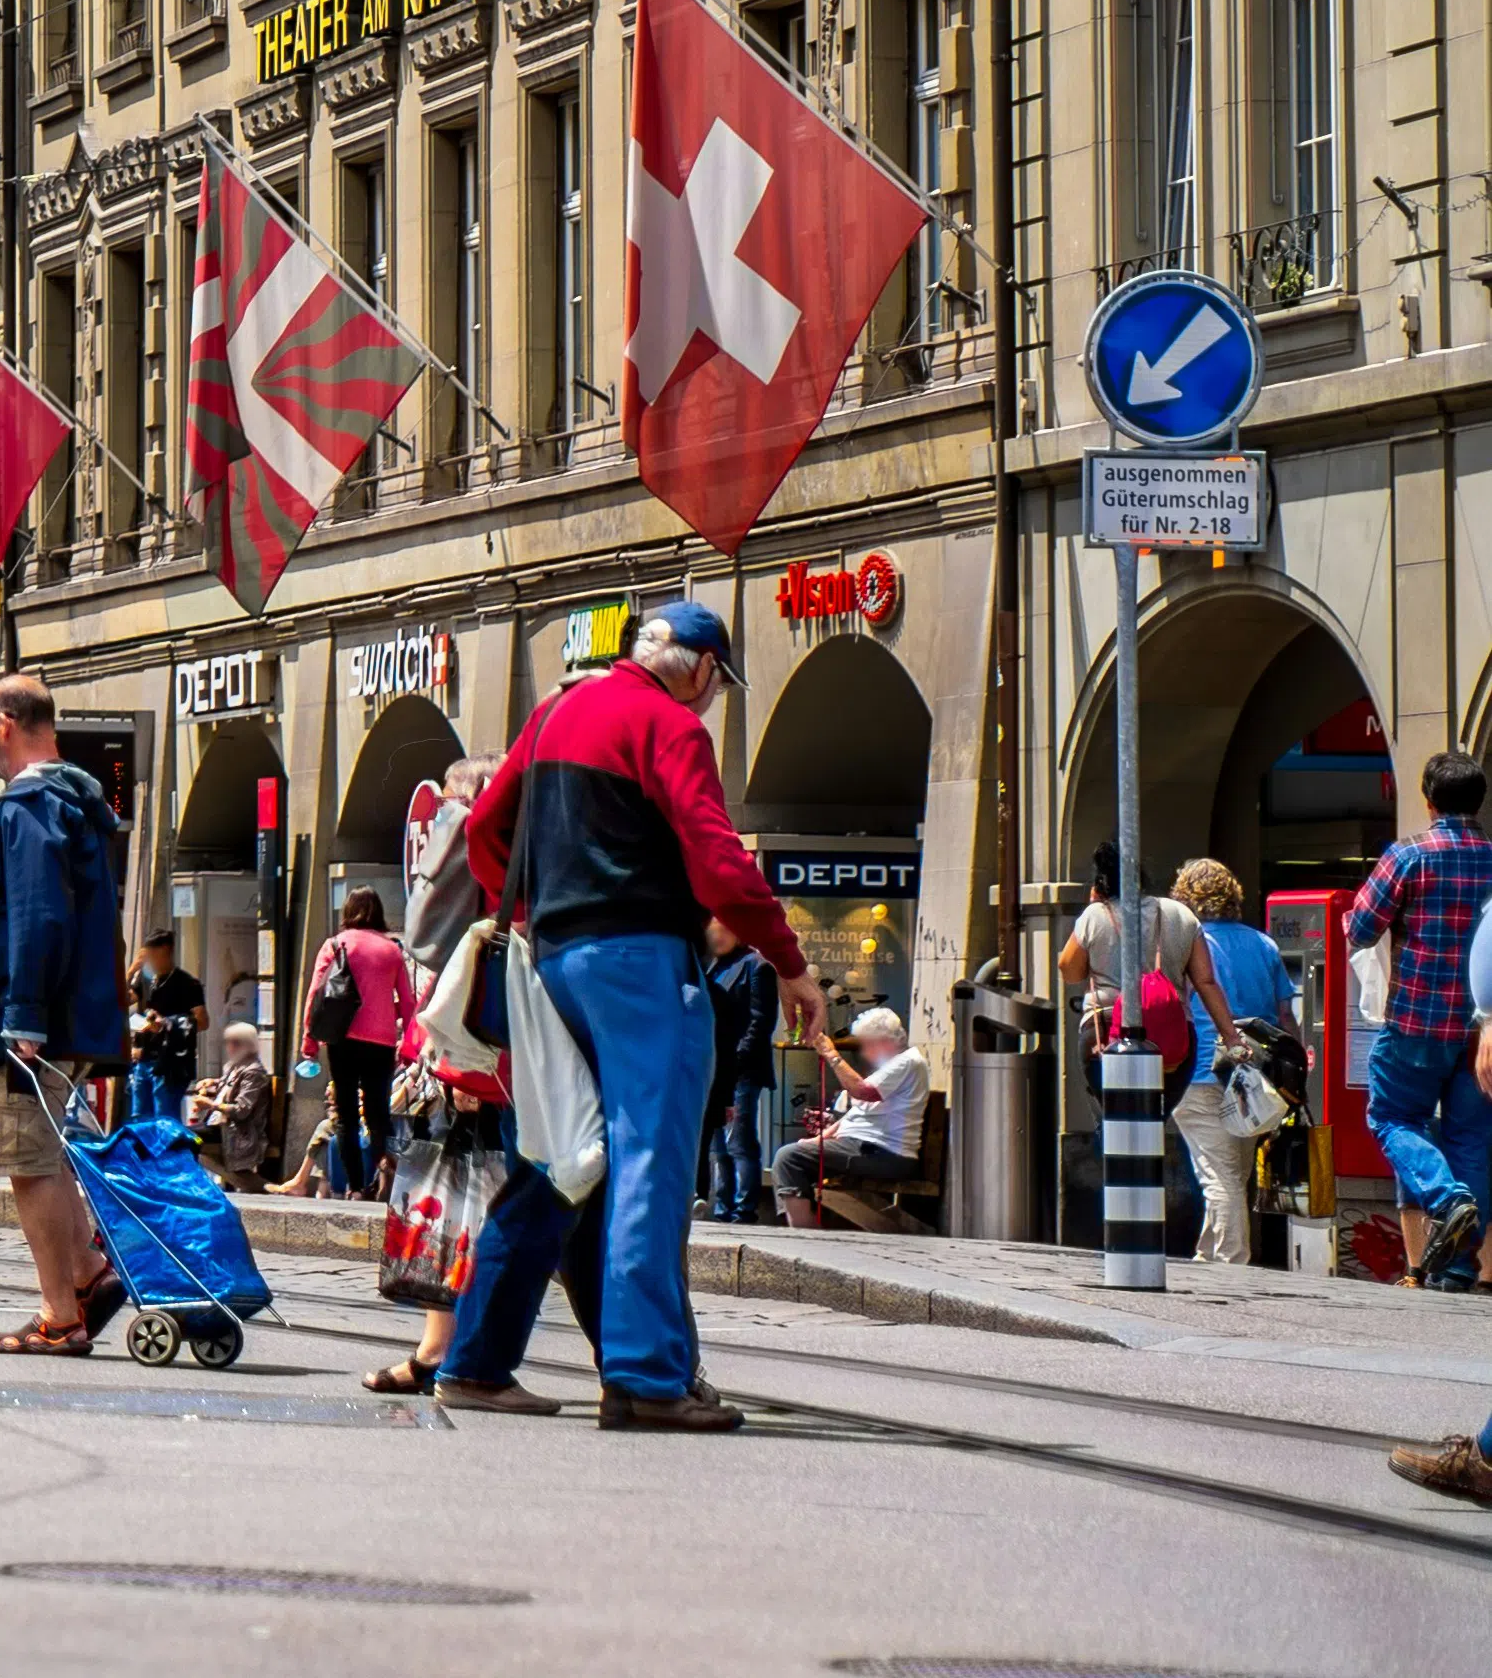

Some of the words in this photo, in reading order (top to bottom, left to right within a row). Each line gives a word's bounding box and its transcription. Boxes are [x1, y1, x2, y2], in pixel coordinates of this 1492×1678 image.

[1104, 466, 1246, 486] ausgenommen
[1102, 489, 1249, 514] Güterumschlag
[1121, 514, 1149, 533] für
[1156, 516, 1181, 534] Nr.
[1189, 517, 1231, 534] 2-18
[563, 601, 629, 663] SUBWAY
[175, 650, 263, 715] DEPOT
[779, 863, 914, 887] DEPOT
